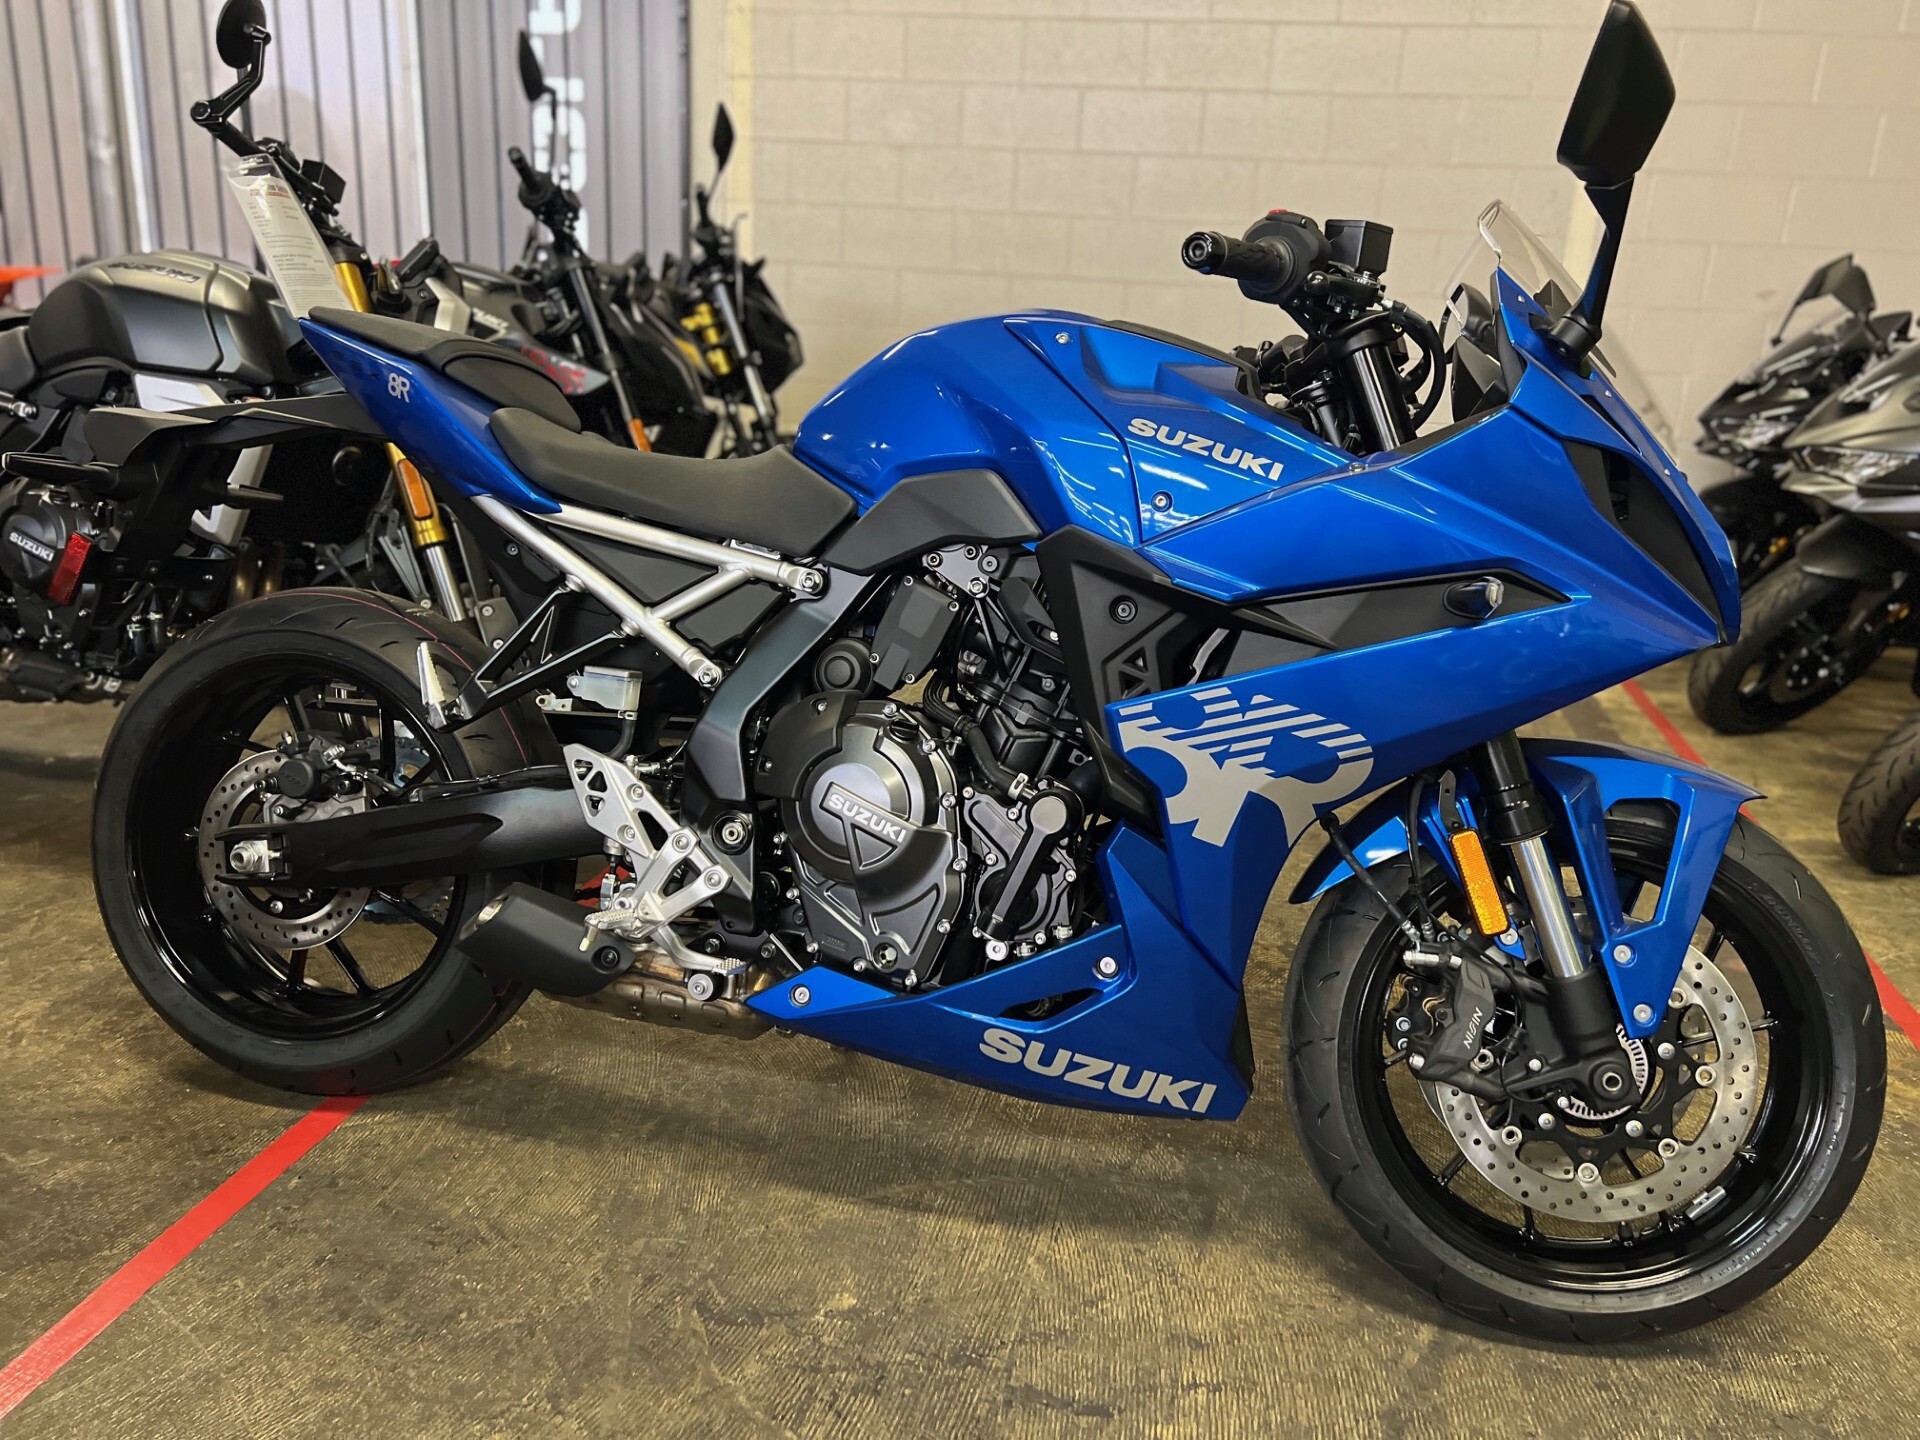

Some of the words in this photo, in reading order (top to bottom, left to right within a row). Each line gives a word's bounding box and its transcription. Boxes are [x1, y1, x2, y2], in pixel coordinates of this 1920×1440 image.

[387, 372, 410, 404] 8R
[1127, 418, 1284, 482] SUZUKI
[9, 531, 55, 562] SUZUKI
[828, 793, 907, 843] SUZUKI
[979, 1028, 1217, 1113] SUZUKI
